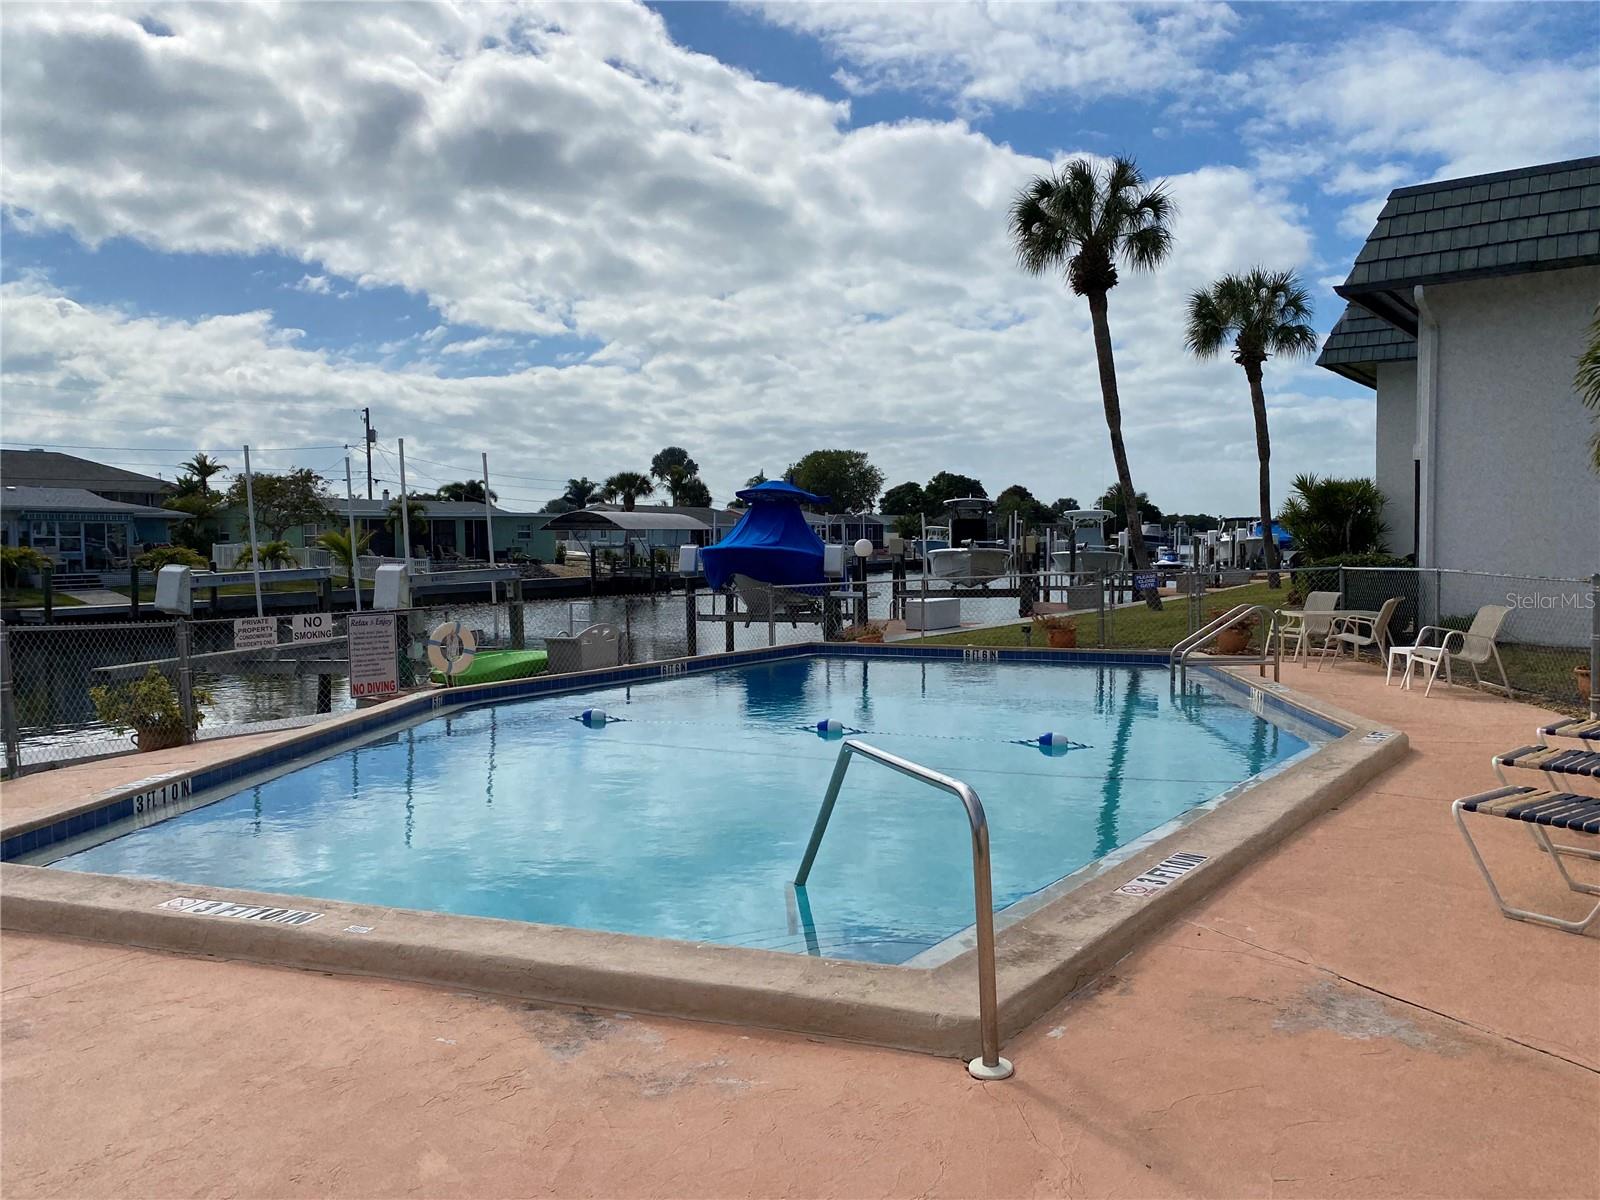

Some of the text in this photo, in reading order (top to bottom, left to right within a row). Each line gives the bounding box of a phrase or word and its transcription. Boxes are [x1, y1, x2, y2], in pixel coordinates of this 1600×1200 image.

[241, 618, 269, 626] PRIVATE
[303, 616, 322, 628] NO
[350, 618, 368, 627] Relax
[375, 618, 393, 628] Enjoy
[238, 625, 273, 634] PROPERTY
[294, 629, 332, 640] SMOKING
[352, 680, 396, 696] NO DIVING
[136, 795, 143, 813] 3
